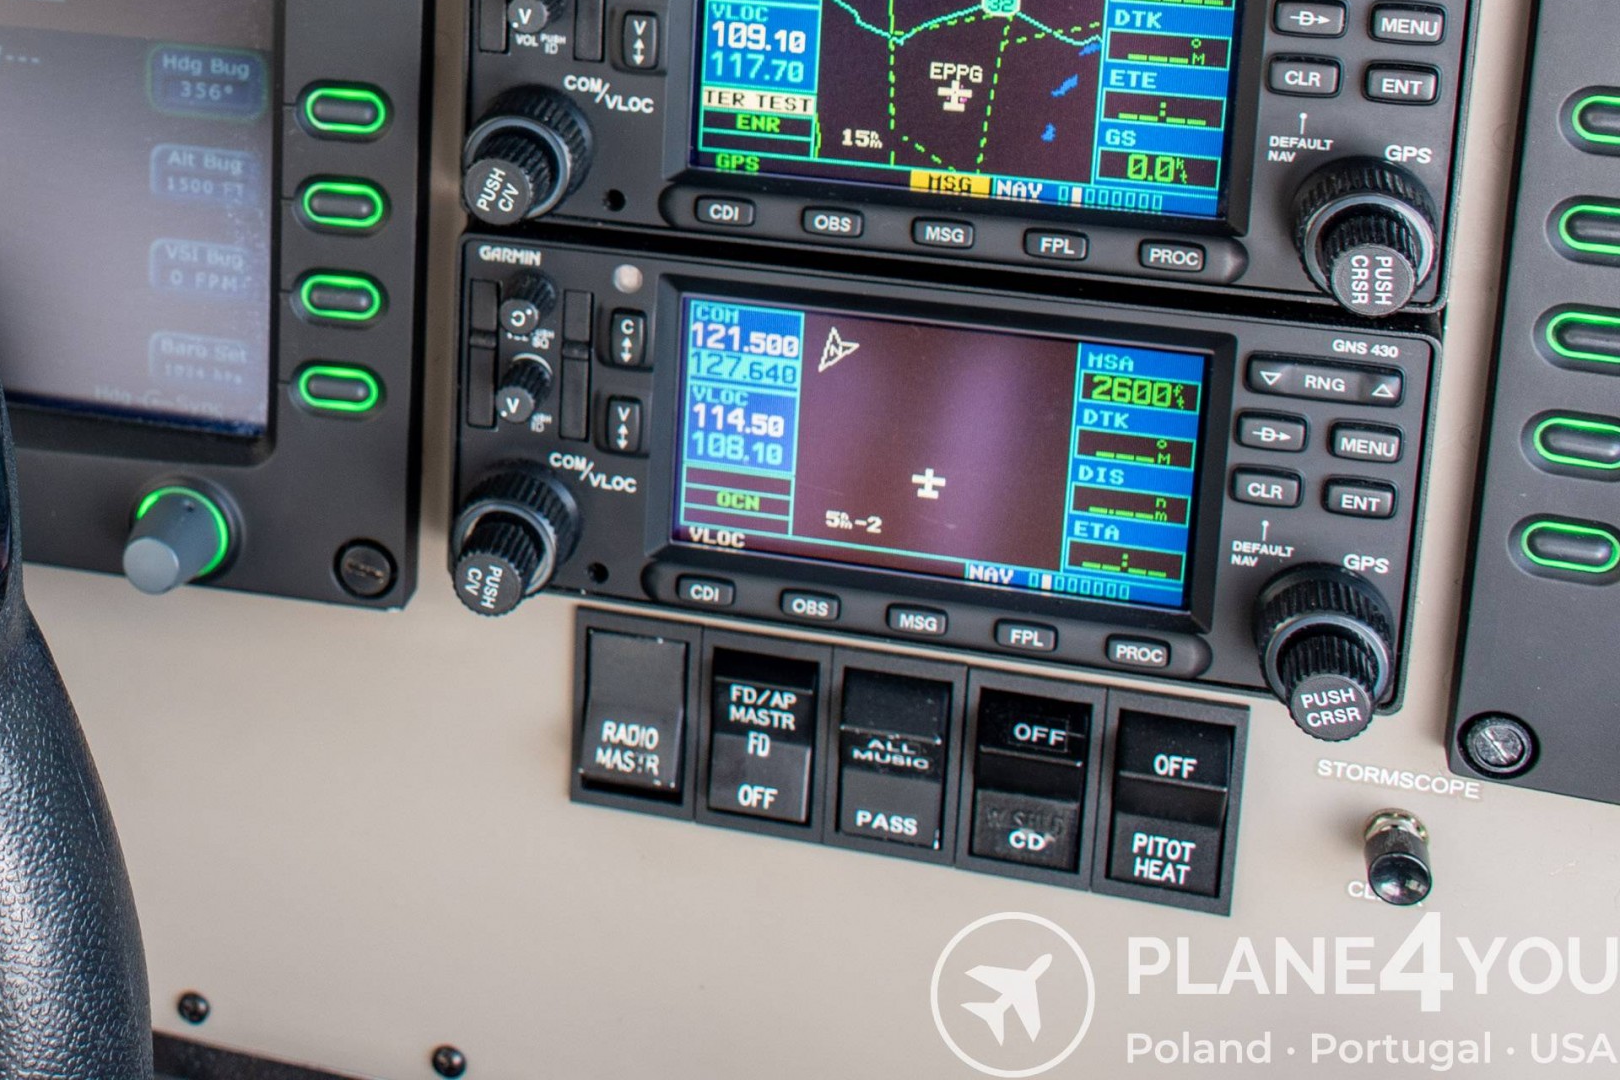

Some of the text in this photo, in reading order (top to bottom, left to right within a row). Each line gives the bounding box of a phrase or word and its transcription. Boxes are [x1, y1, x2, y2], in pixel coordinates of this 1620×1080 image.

[712, 3, 769, 22] VLOC
[1114, 9, 1162, 29] DTK
[1381, 17, 1438, 36] MENU
[712, 20, 806, 54] 109.10
[162, 53, 250, 80] Hdg Bug
[711, 51, 804, 83] 117.70
[930, 62, 983, 83] EPPG
[1109, 72, 1158, 90] ETE
[1284, 70, 1322, 88] CLR
[1382, 77, 1423, 95] ENT
[704, 89, 813, 113] TER TEST
[736, 114, 780, 133] ENR
[1105, 128, 1136, 146] GS
[1269, 135, 1334, 151] DEFAULT
[715, 153, 760, 172] GPS
[1268, 150, 1296, 163] NAV
[1384, 144, 1433, 164] GPS
[709, 204, 739, 221] CDI
[814, 214, 852, 232] OBS
[925, 225, 964, 243] MSG
[479, 245, 541, 266] GARMIN
[1040, 237, 1075, 255] FPL
[1149, 248, 1199, 266] PROC
[696, 305, 739, 322] COM
[692, 322, 799, 357] 121.500
[1332, 339, 1399, 358] GNS 430
[1304, 374, 1346, 392] RNG
[692, 385, 749, 407] VLOC
[692, 403, 784, 438] 114.50
[1082, 409, 1129, 429] DTK
[692, 430, 783, 465] 108.10
[1340, 437, 1396, 457] MENU
[1078, 465, 1125, 484] DIS
[1247, 482, 1283, 499] CLR
[1341, 495, 1380, 513] ENT
[689, 526, 746, 547] VLOC
[1073, 521, 1120, 541] ETA
[1232, 540, 1294, 558] DEFAULT
[1231, 554, 1258, 567] NAV
[1342, 553, 1390, 574] GPS
[968, 565, 1014, 585] NAV
[690, 584, 720, 602] CDI
[792, 599, 829, 618] OBS
[899, 614, 937, 631] MSG
[1010, 628, 1043, 647] FPL
[1115, 644, 1163, 663] PROC
[730, 683, 797, 710] FD/AP
[1300, 688, 1356, 709] PUSH
[730, 705, 796, 730] MASTR
[1306, 707, 1362, 728] CRSR
[602, 720, 659, 751] RADIO
[1013, 723, 1067, 746] OFF
[747, 732, 770, 758] FD
[1153, 755, 1197, 779] OFF
[1317, 759, 1480, 799] STORMSCOPE
[738, 784, 778, 810] OFF
[856, 810, 918, 836] PASS
[1132, 833, 1196, 862] PITOT
[1133, 858, 1191, 884] HEAT
